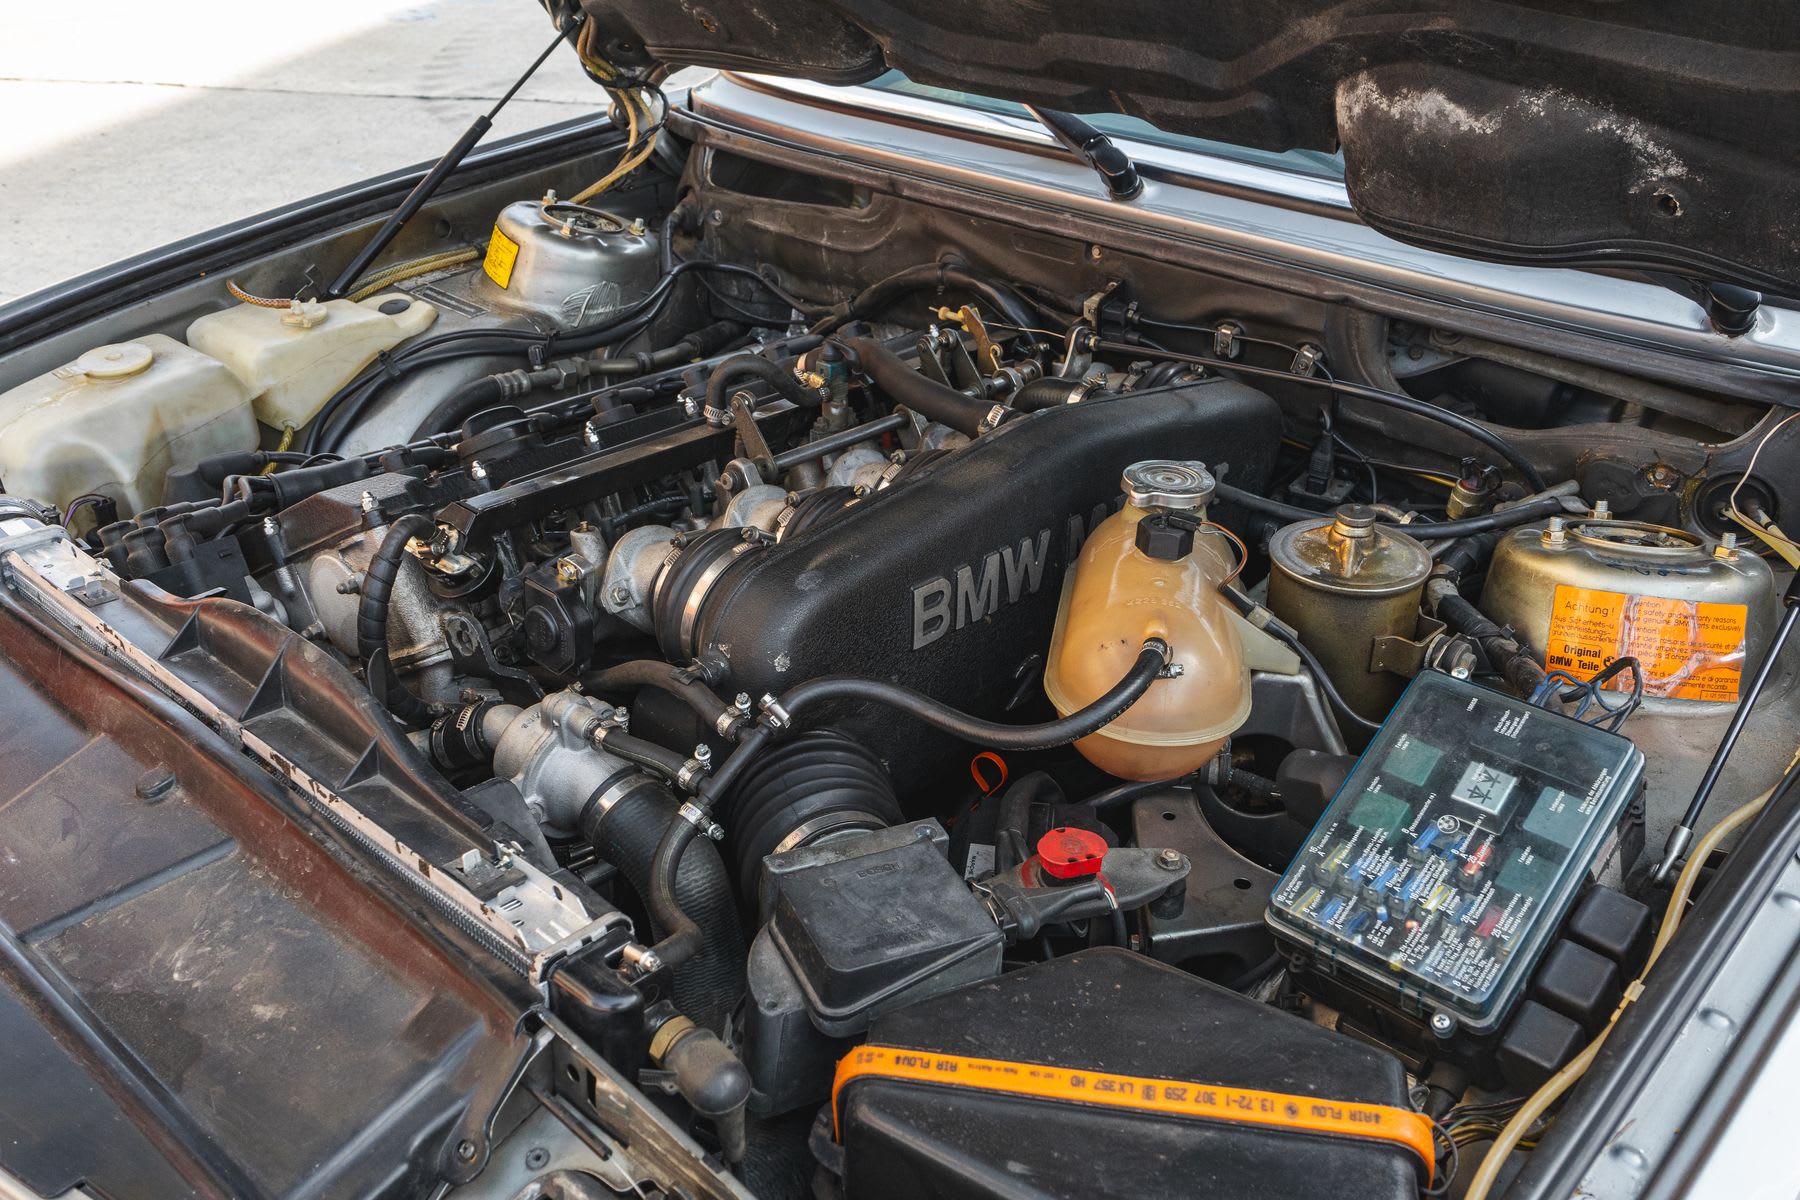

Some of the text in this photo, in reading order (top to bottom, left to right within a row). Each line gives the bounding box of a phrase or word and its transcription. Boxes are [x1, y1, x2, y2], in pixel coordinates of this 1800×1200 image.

[911, 528, 1050, 650] BMW
[1565, 601, 1608, 617] Achtung
[1711, 624, 1741, 632] exclusively
[1564, 645, 1601, 658] Original
[1549, 655, 1600, 671] BMW Teile
[899, 1055, 930, 1069] FLOW
[936, 1060, 957, 1072] AIR
[1071, 1076, 1086, 1088] HD
[1164, 1088, 1187, 1102] 259
[1195, 1091, 1216, 1105] 307
[1225, 1094, 1275, 1113] 13.72-1
[1311, 1104, 1342, 1119] FLOW
[1349, 1108, 1372, 1122] AIR
